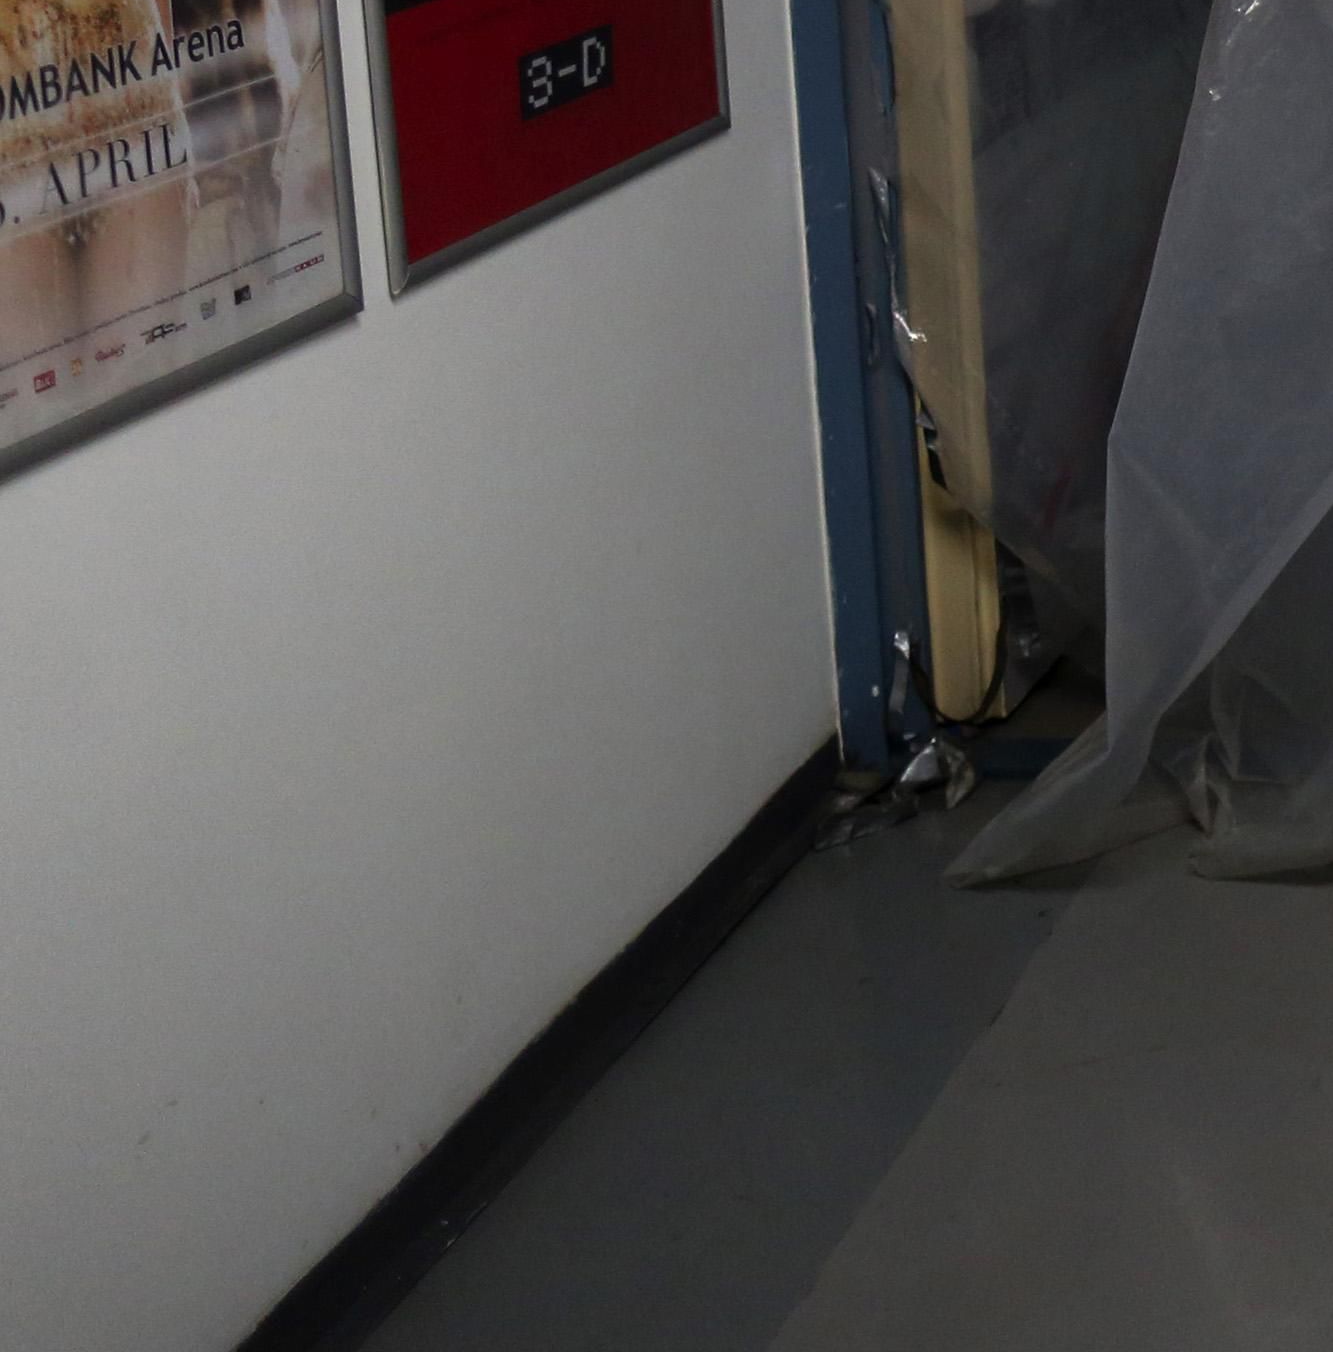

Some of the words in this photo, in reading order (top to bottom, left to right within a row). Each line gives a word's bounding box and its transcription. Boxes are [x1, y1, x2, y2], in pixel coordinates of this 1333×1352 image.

[0, 40, 142, 121] MBANK
[151, 18, 245, 76] Arena
[527, 36, 605, 109] 3-D
[39, 123, 188, 216] APRIL
